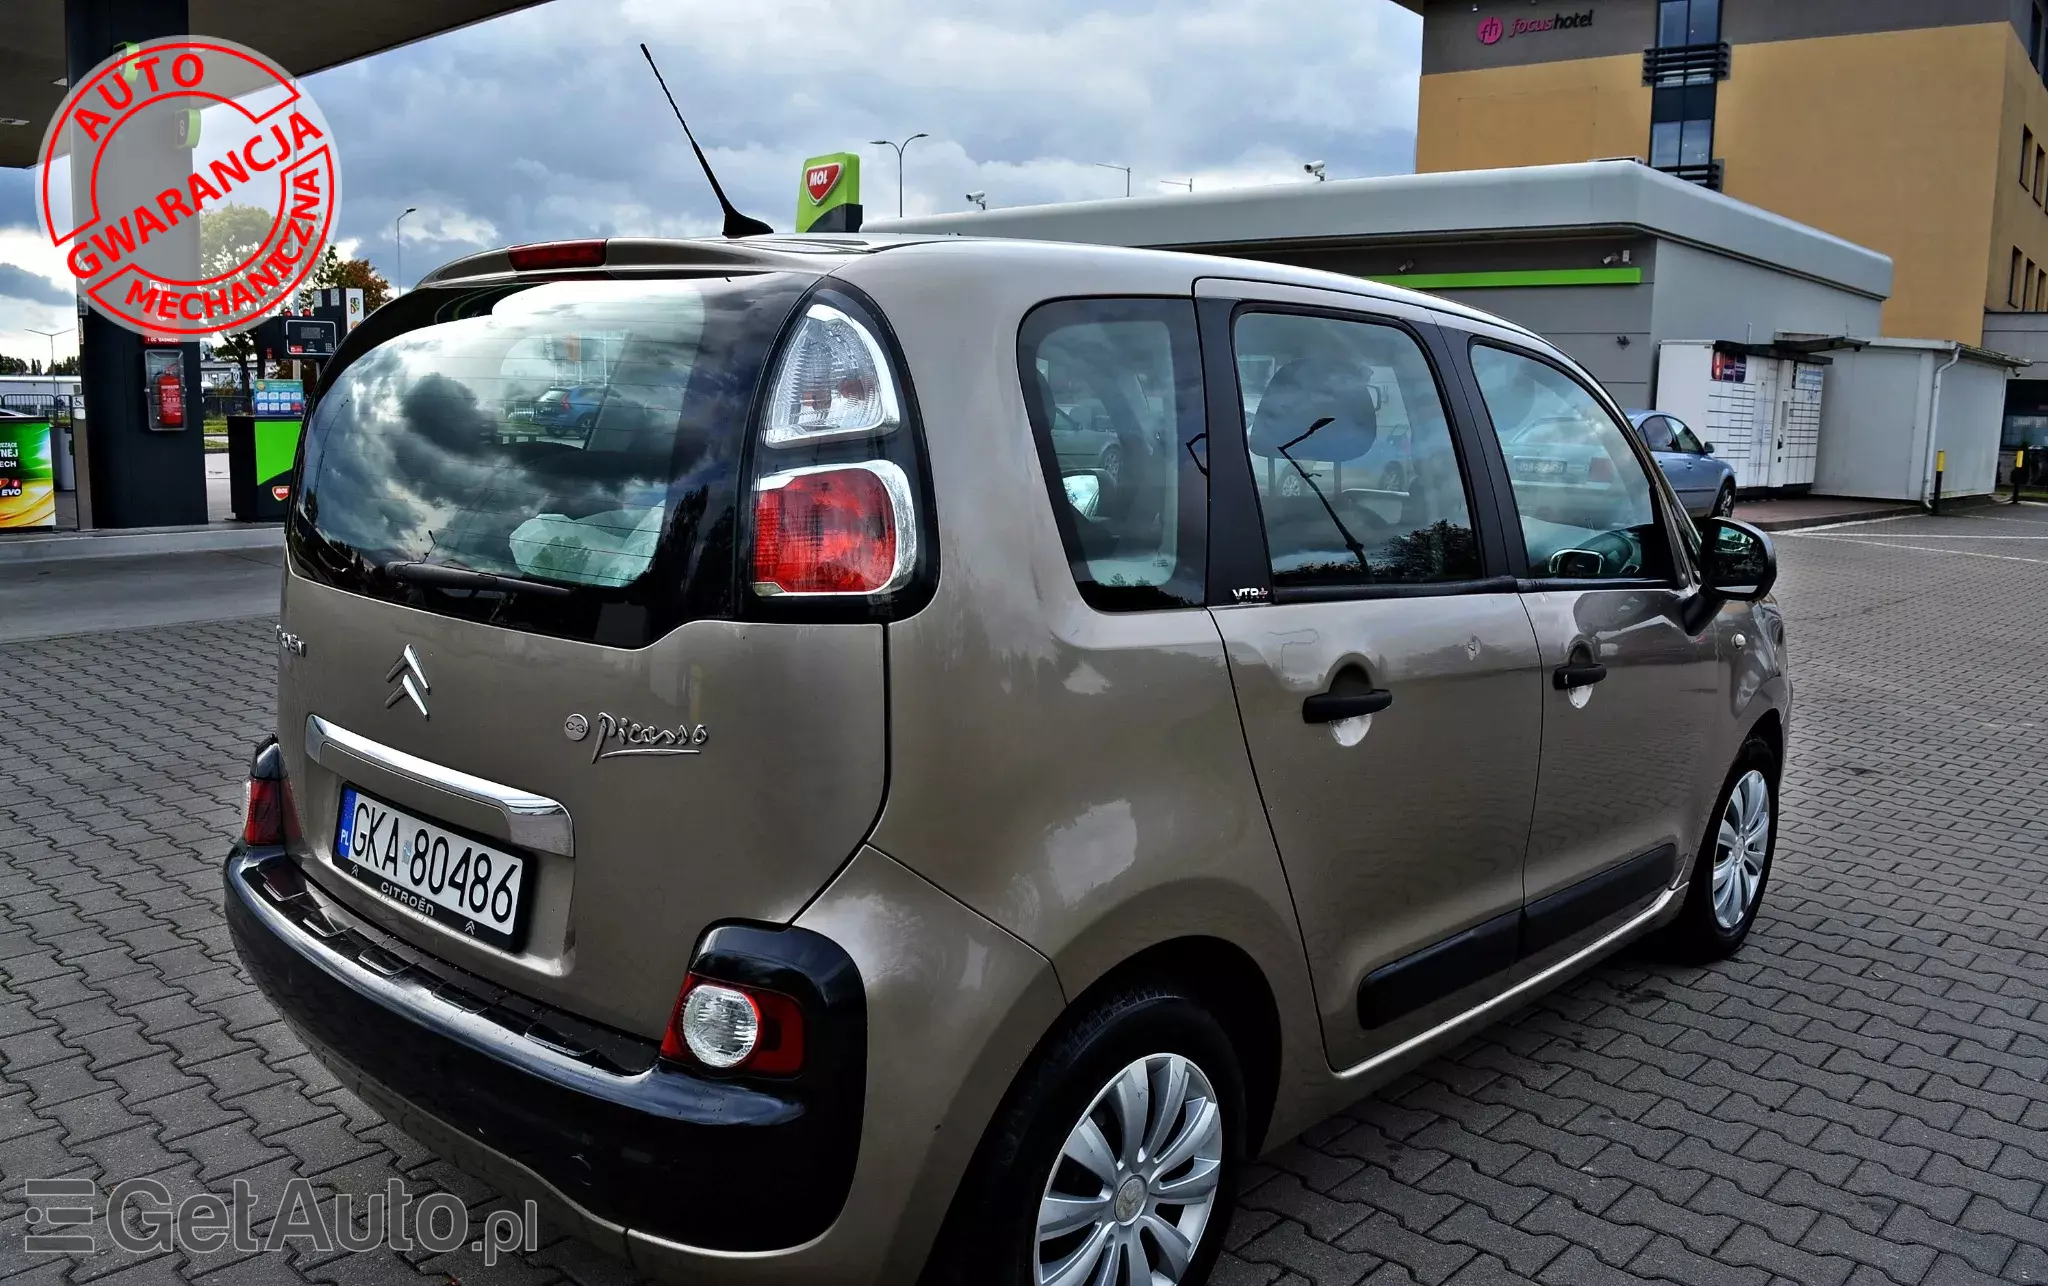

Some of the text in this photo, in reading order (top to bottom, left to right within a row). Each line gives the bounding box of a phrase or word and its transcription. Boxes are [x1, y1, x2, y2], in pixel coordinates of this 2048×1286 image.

[809, 169, 828, 187] MOL
[1, 488, 22, 497] EVO
[591, 711, 708, 764] Picasso
[340, 828, 349, 847] PL
[352, 802, 519, 924] GKA 80486
